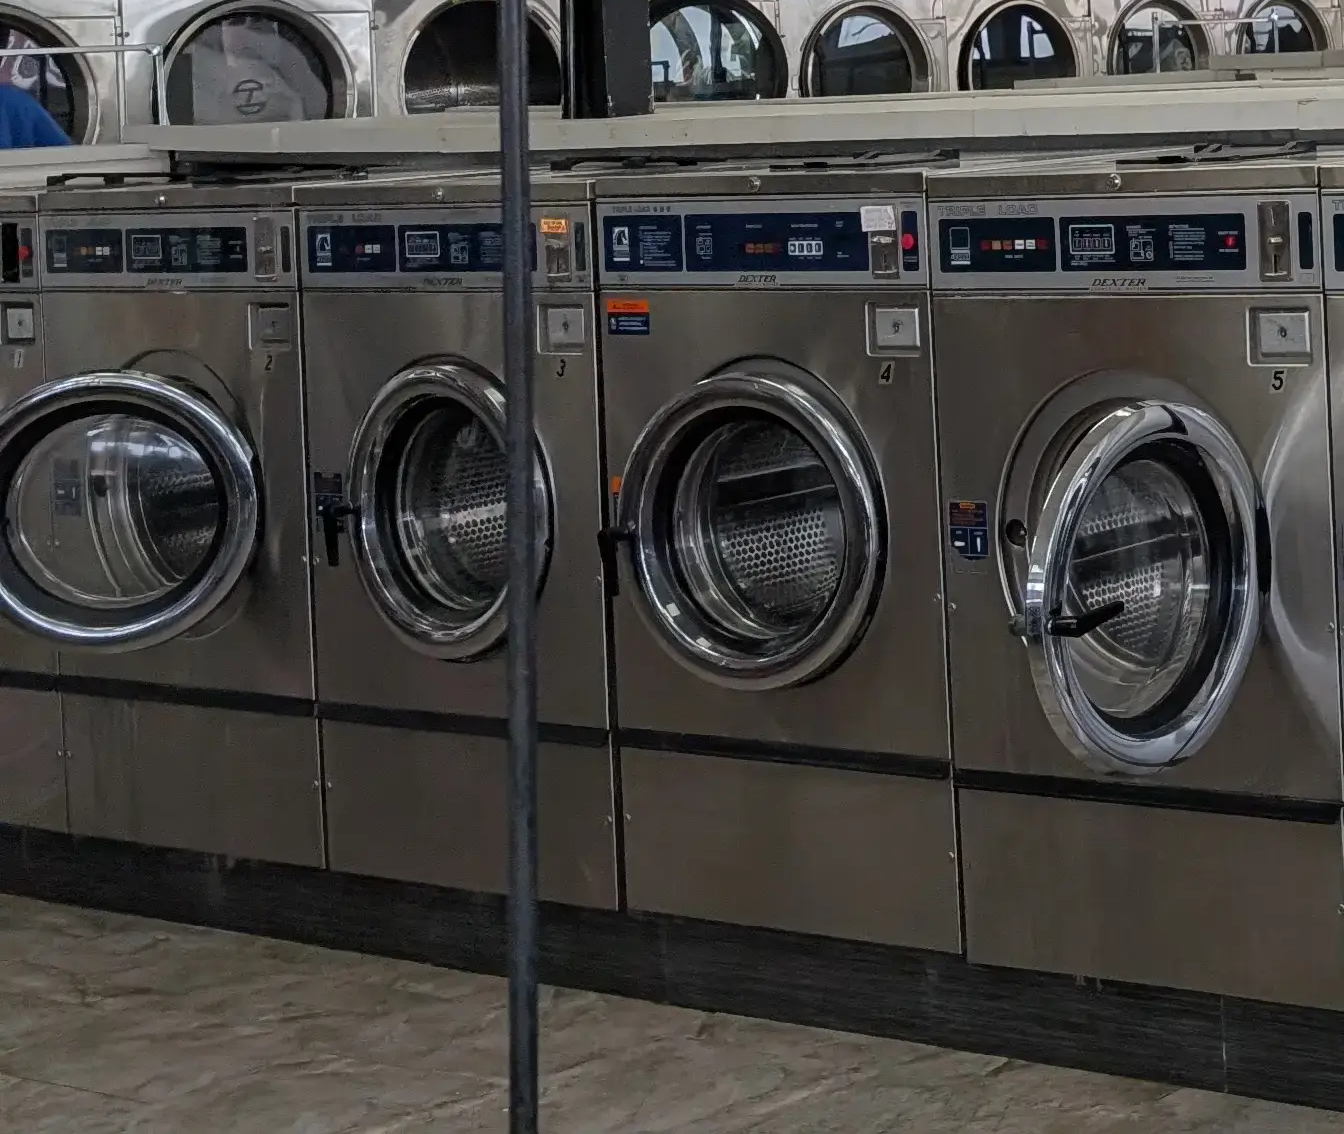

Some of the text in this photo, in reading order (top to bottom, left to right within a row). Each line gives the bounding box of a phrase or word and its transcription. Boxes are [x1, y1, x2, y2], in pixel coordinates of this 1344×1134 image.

[938, 204, 1039, 216] TRIPLE LOAD
[738, 274, 777, 283] DEXTER
[1091, 278, 1146, 287] DEXTER
[264, 354, 273, 371] 2
[556, 358, 566, 377] 3
[880, 363, 892, 382] 4
[1271, 370, 1285, 391] 5
